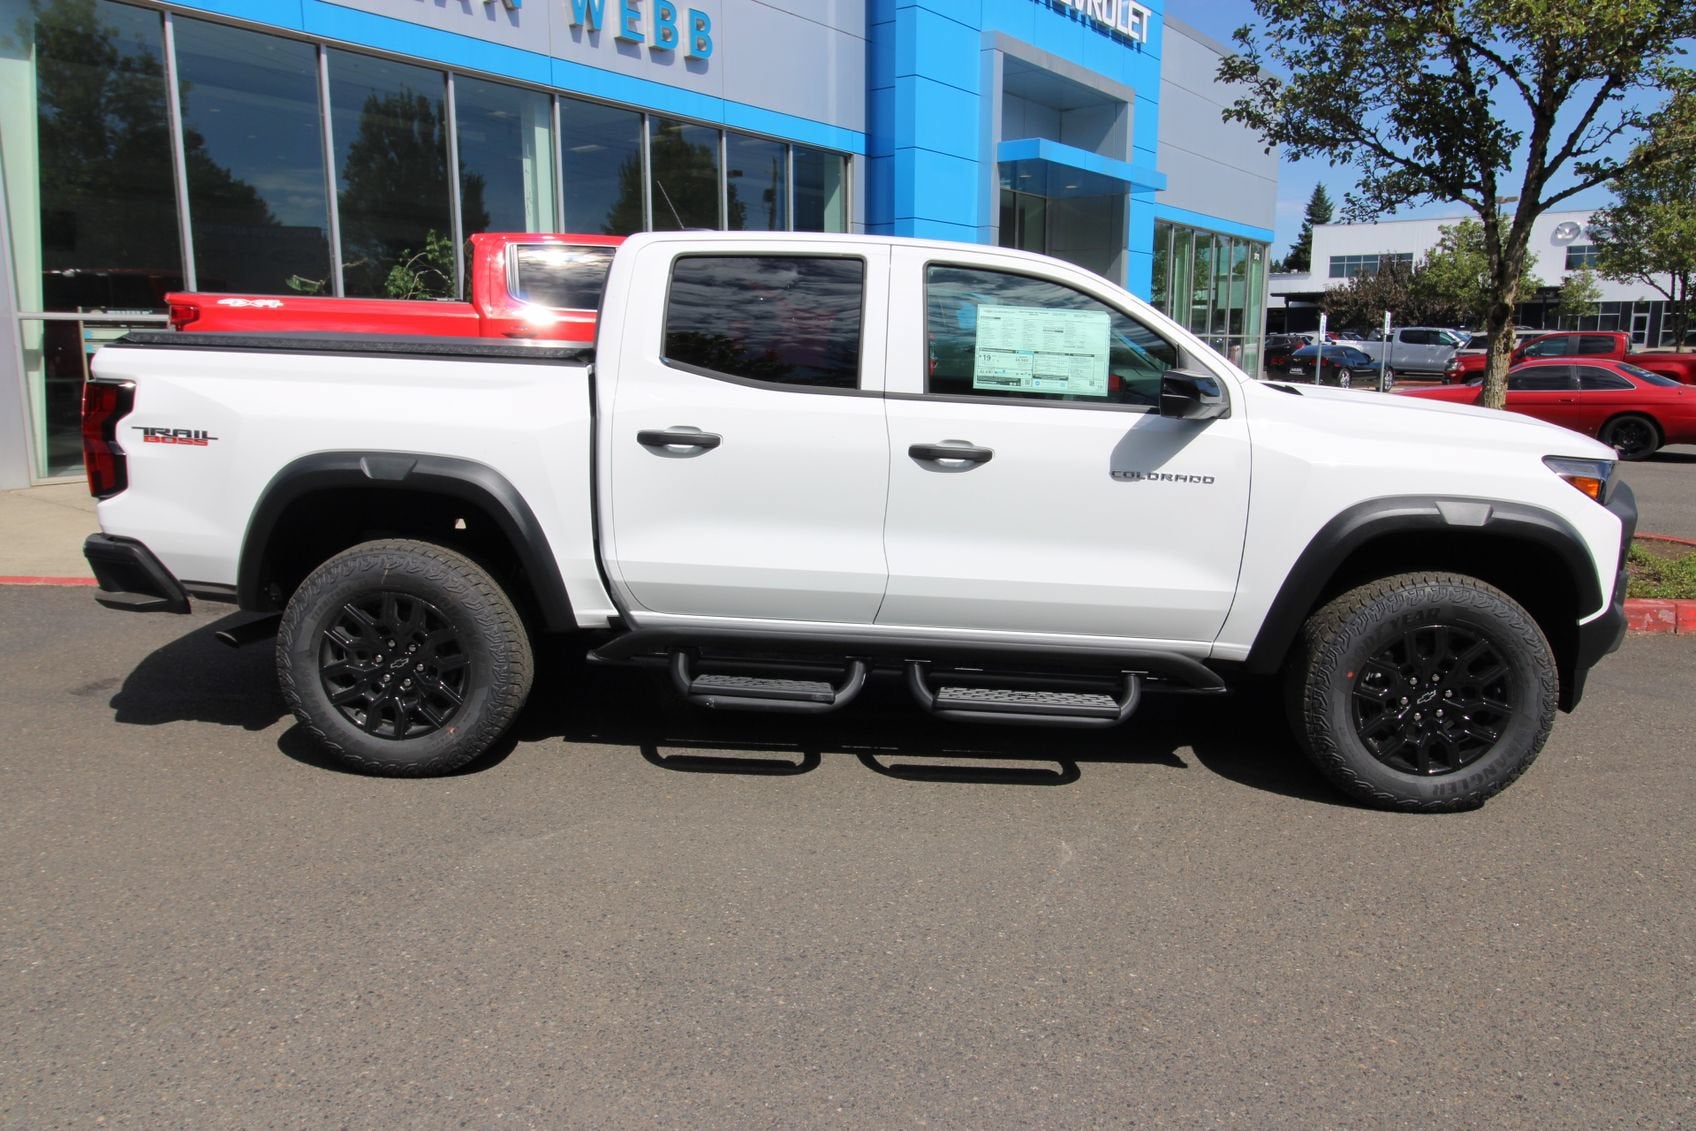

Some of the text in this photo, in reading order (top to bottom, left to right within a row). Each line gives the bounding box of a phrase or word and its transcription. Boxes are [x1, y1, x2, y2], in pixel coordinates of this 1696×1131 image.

[131, 426, 219, 441] TRAIL
[143, 435, 208, 447] BOSS
[1111, 470, 1215, 485] COLORADO
